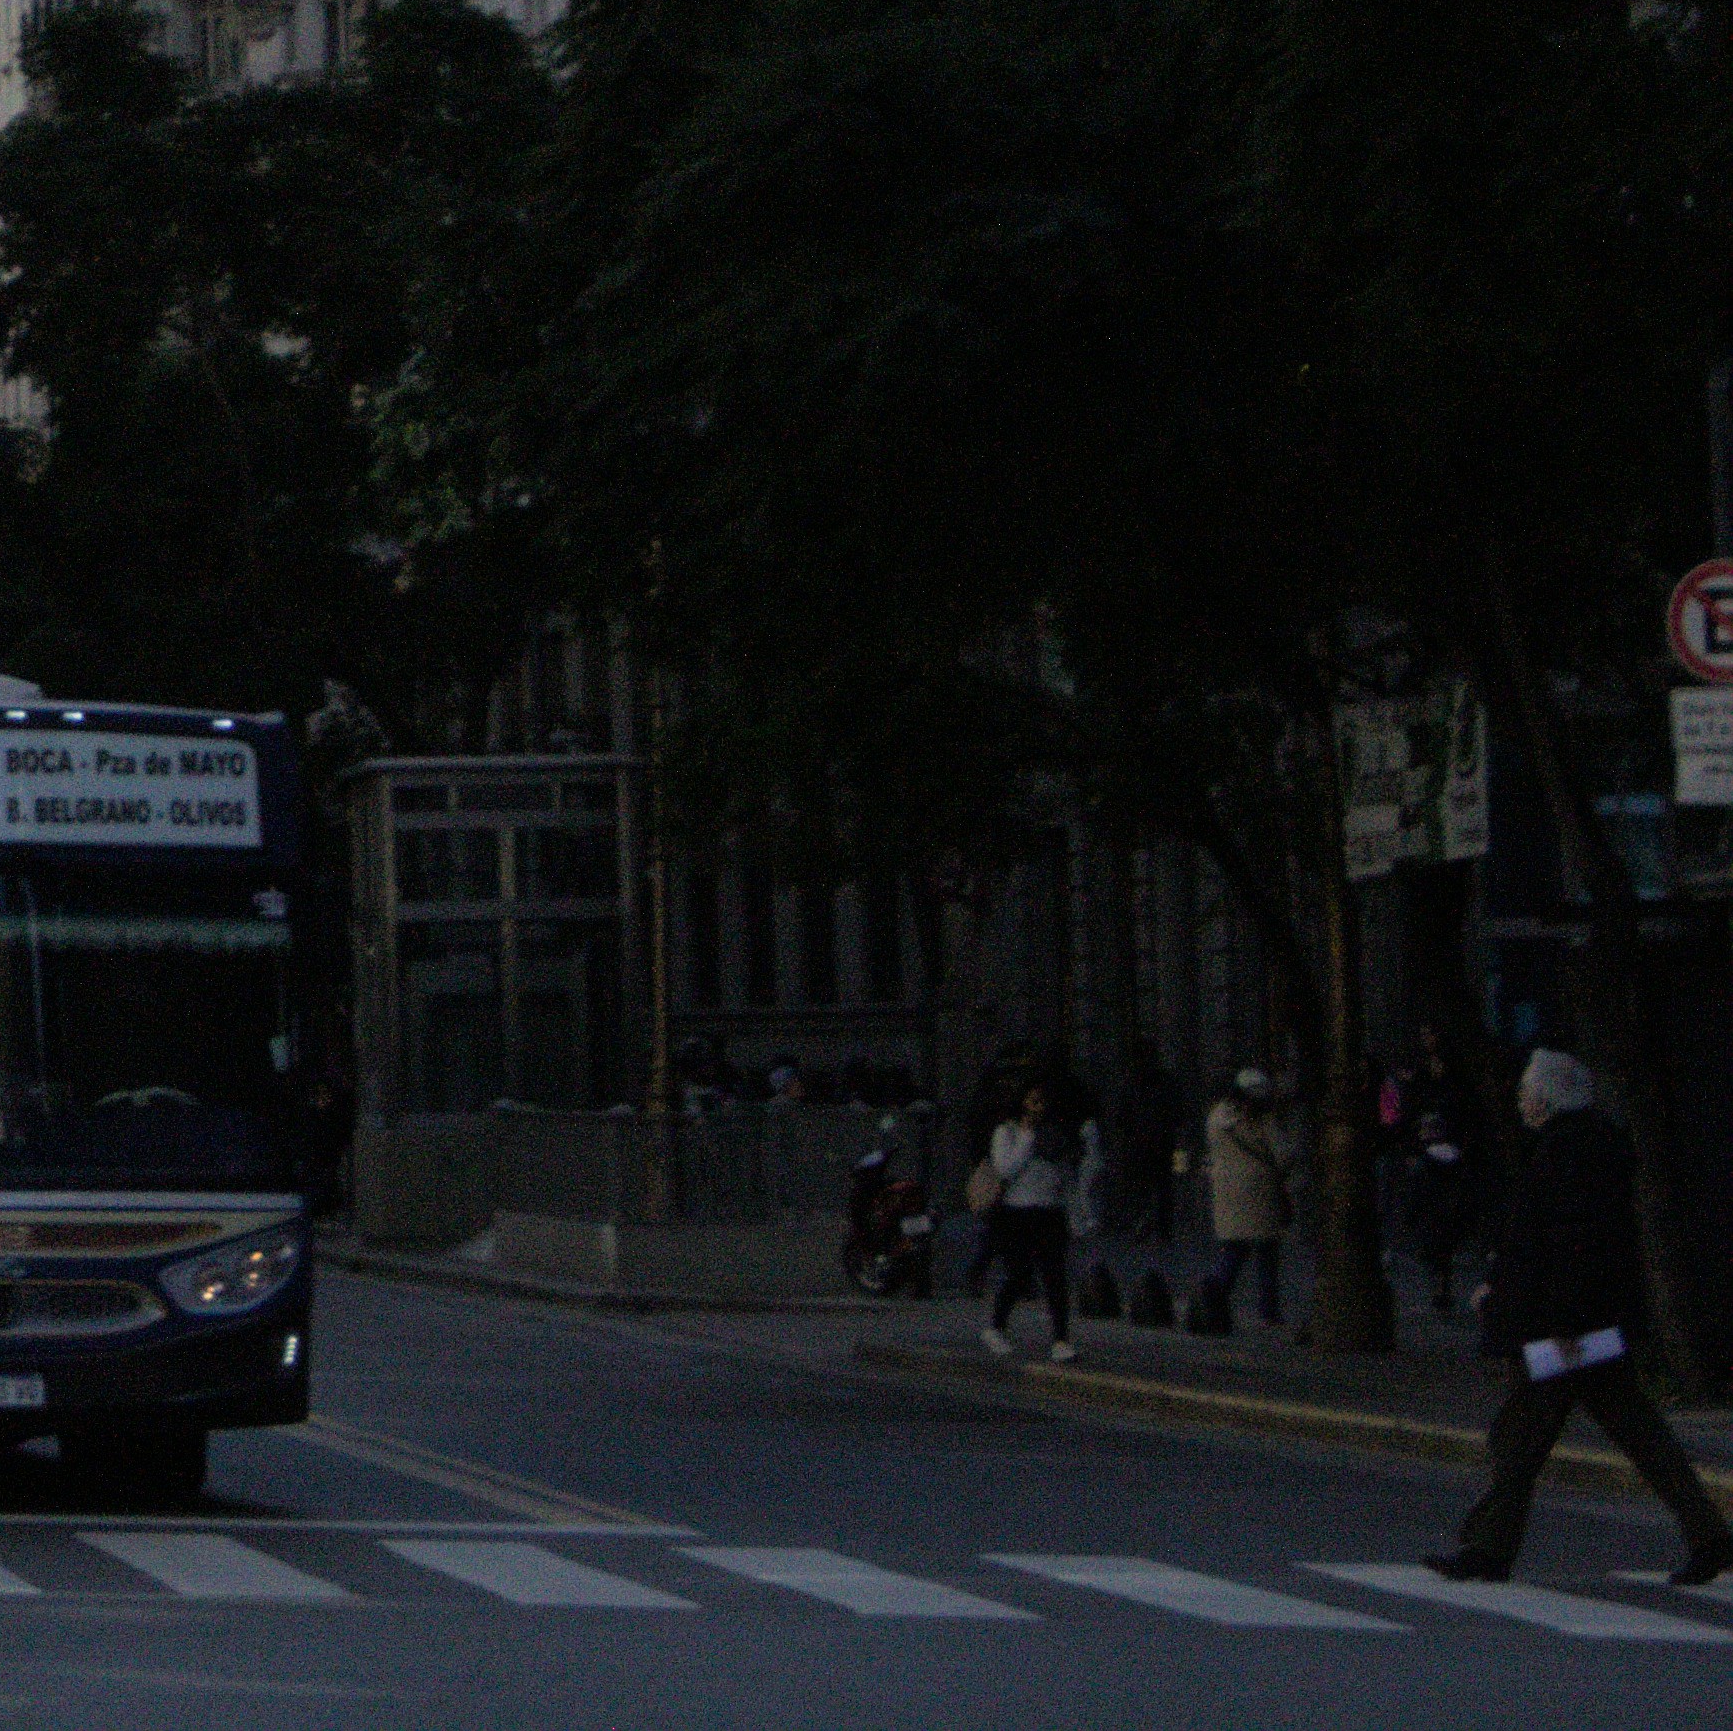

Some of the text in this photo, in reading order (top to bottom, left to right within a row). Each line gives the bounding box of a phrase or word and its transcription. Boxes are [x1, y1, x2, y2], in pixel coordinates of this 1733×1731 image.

[7, 748, 72, 773] BOCA
[96, 748, 135, 774] Pza
[145, 751, 171, 774] de
[180, 750, 246, 776] MAYO
[35, 796, 151, 825] BELGRANO
[171, 798, 245, 826] OLIVOS
